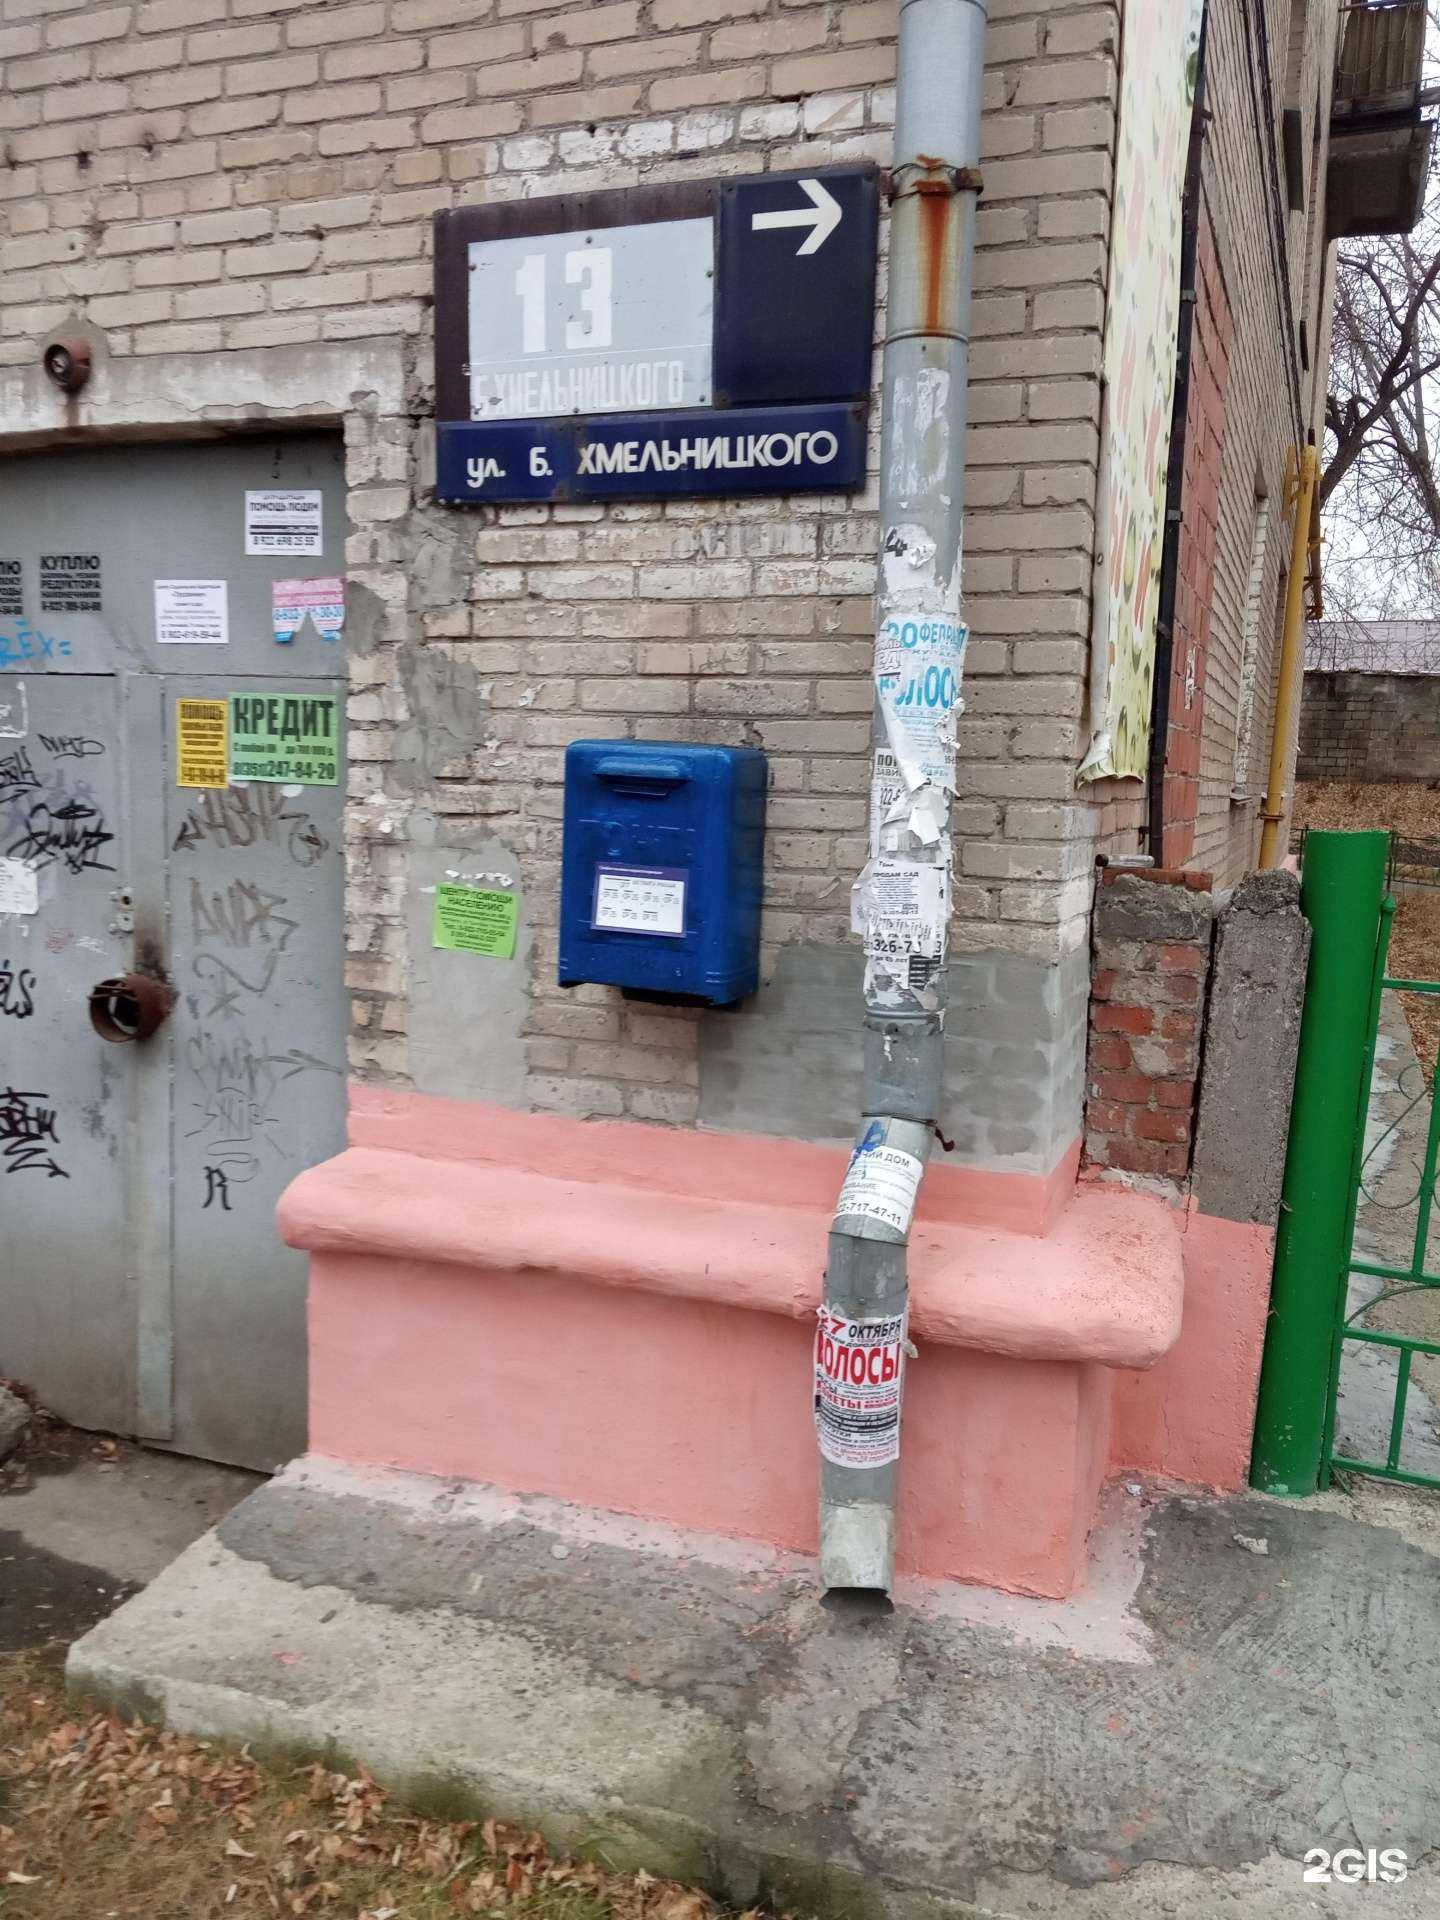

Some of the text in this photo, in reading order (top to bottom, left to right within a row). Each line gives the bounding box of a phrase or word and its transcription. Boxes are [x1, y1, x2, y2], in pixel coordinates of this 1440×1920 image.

[515, 248, 612, 353] 13
[467, 430, 839, 488] ул. Б. ХМЕЛЬНИЦКОГО
[41, 555, 100, 570] КУПЛЮ
[41, 579, 101, 589] РЕДУКТОРА
[233, 698, 333, 742] КРЕДИТ
[884, 1153, 911, 1169] ДОМ
[848, 1318, 902, 1339] ОКТЯБРЯ
